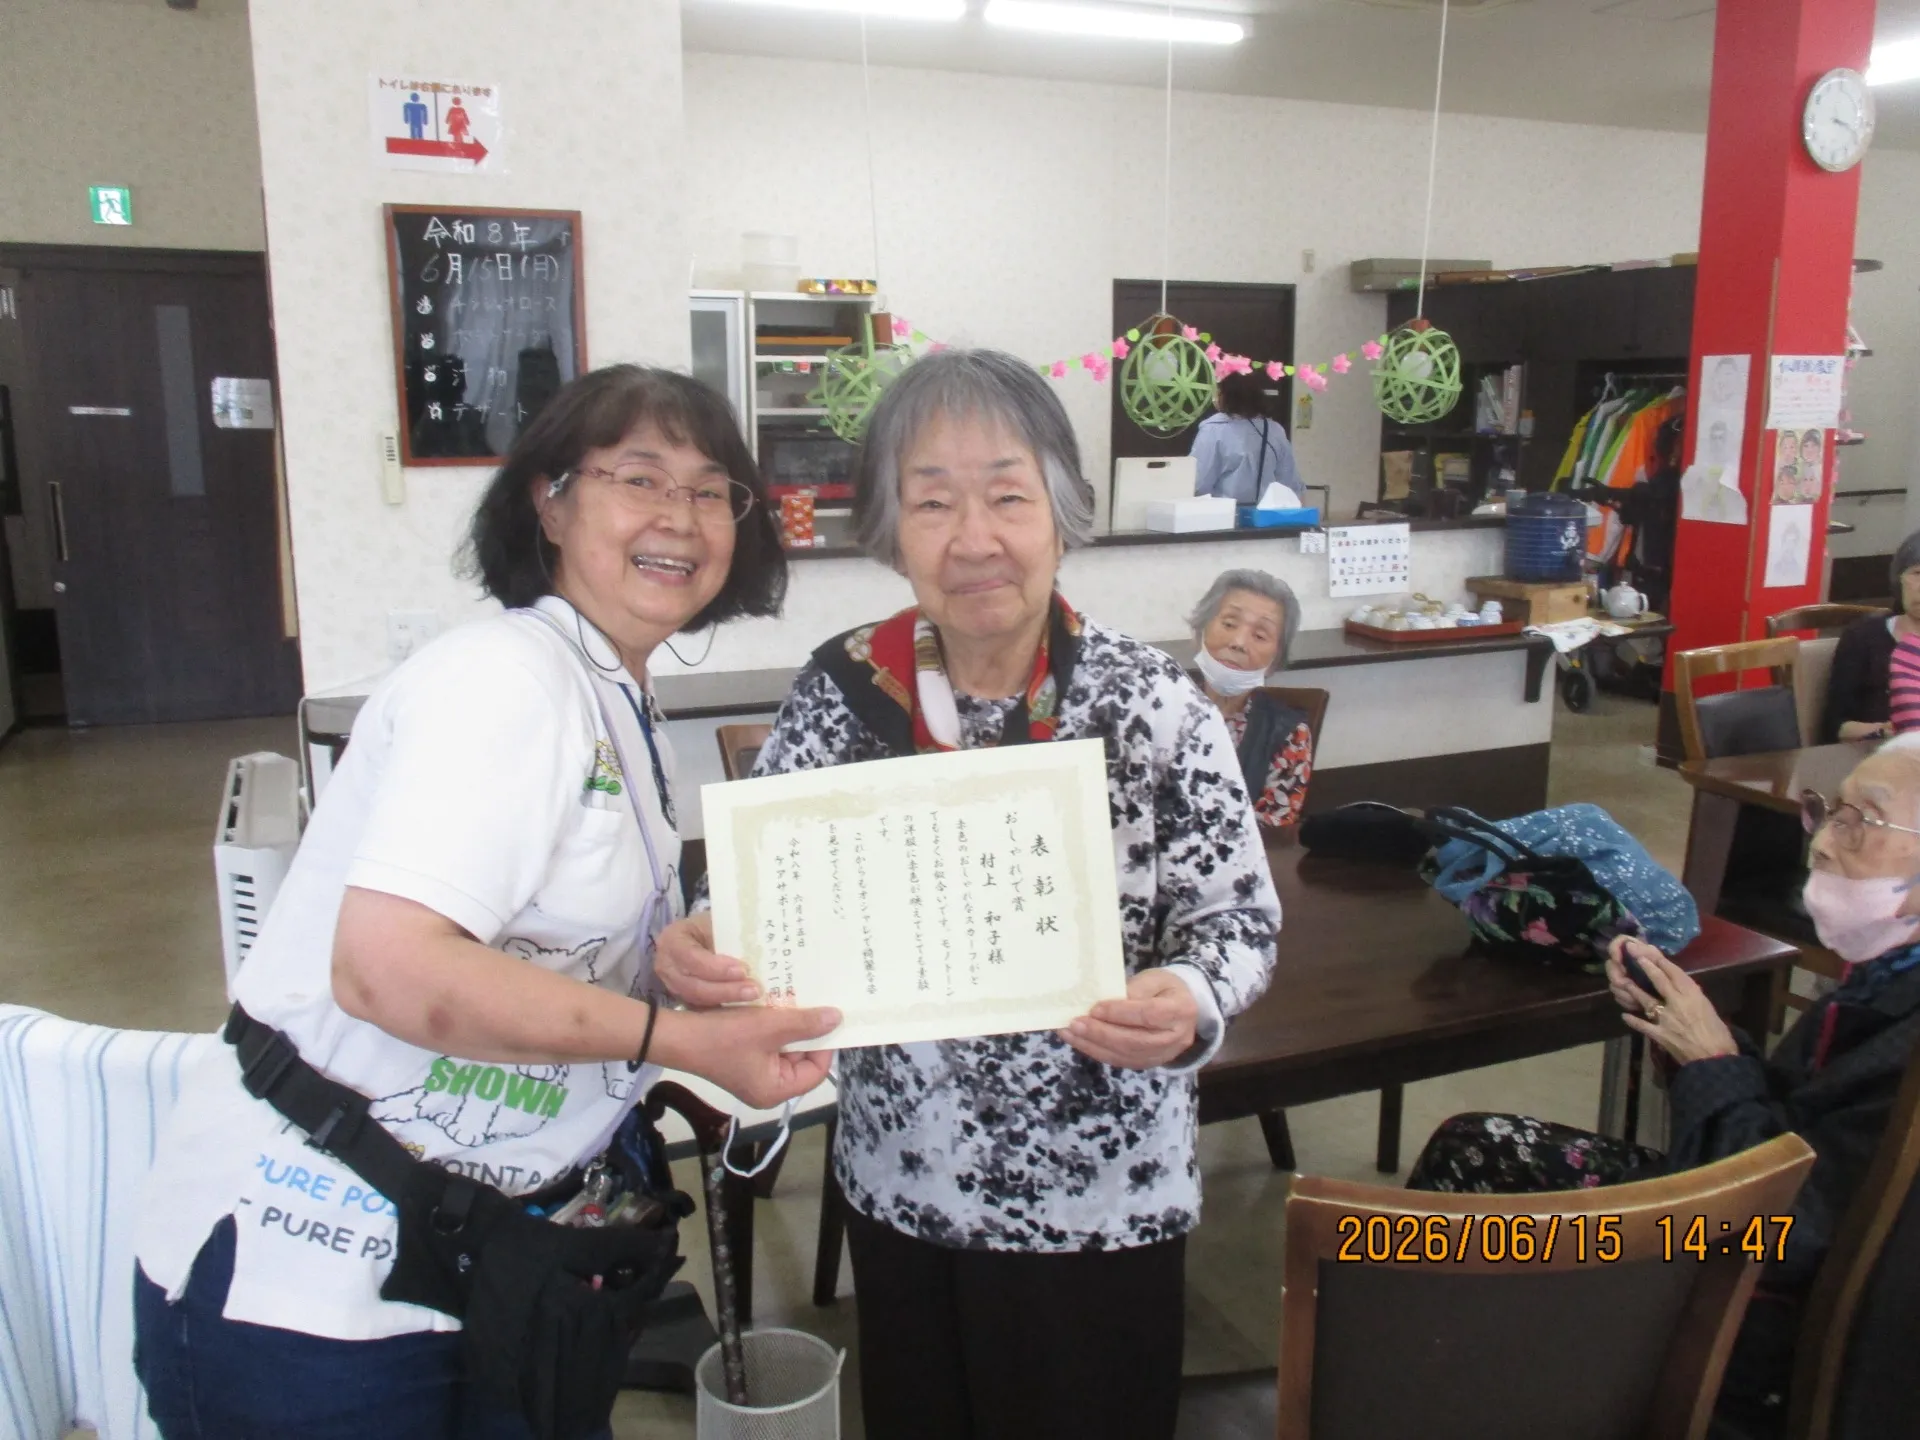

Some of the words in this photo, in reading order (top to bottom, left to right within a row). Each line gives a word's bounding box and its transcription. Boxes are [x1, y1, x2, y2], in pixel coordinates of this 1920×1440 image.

[979, 852, 997, 887] 村上
[1005, 811, 1026, 911] おしゃれで賞
[1030, 834, 1060, 935] 表彰状
[424, 1058, 569, 1118] SHOWN
[260, 1206, 354, 1254] PURE
